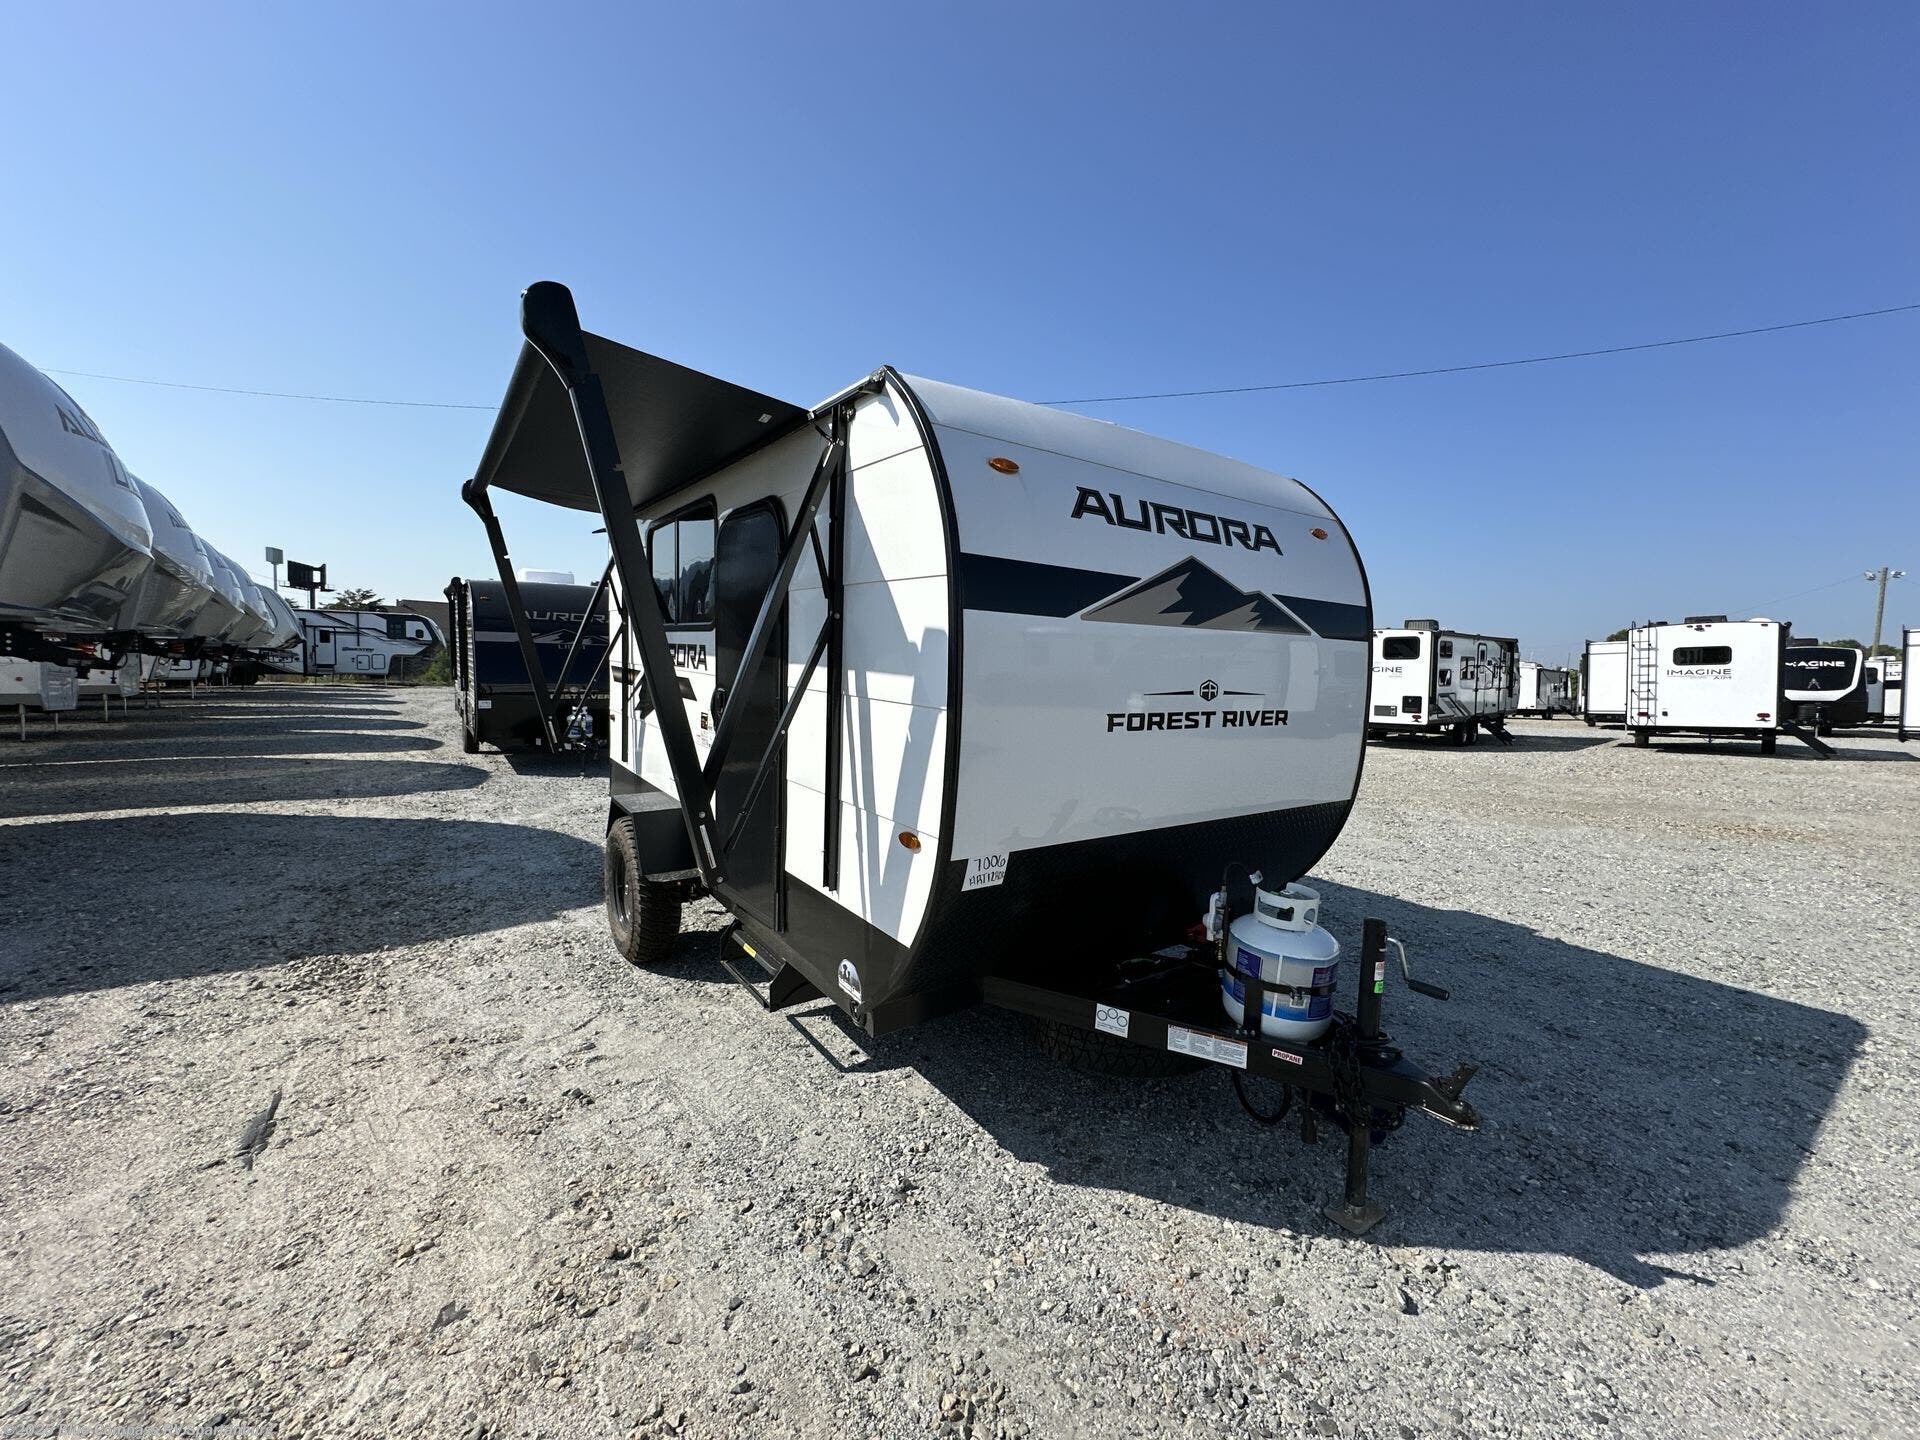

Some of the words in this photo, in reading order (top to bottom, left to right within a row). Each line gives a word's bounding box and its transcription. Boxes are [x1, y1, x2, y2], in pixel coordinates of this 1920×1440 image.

[1071, 486, 1283, 556] AURORA
[668, 643, 708, 671] RORA
[1666, 668, 1732, 676] IMAGINE
[1106, 711, 1217, 733] FOREST
[1222, 710, 1289, 728] RIVER
[1273, 1050, 1302, 1064] PROPANE
